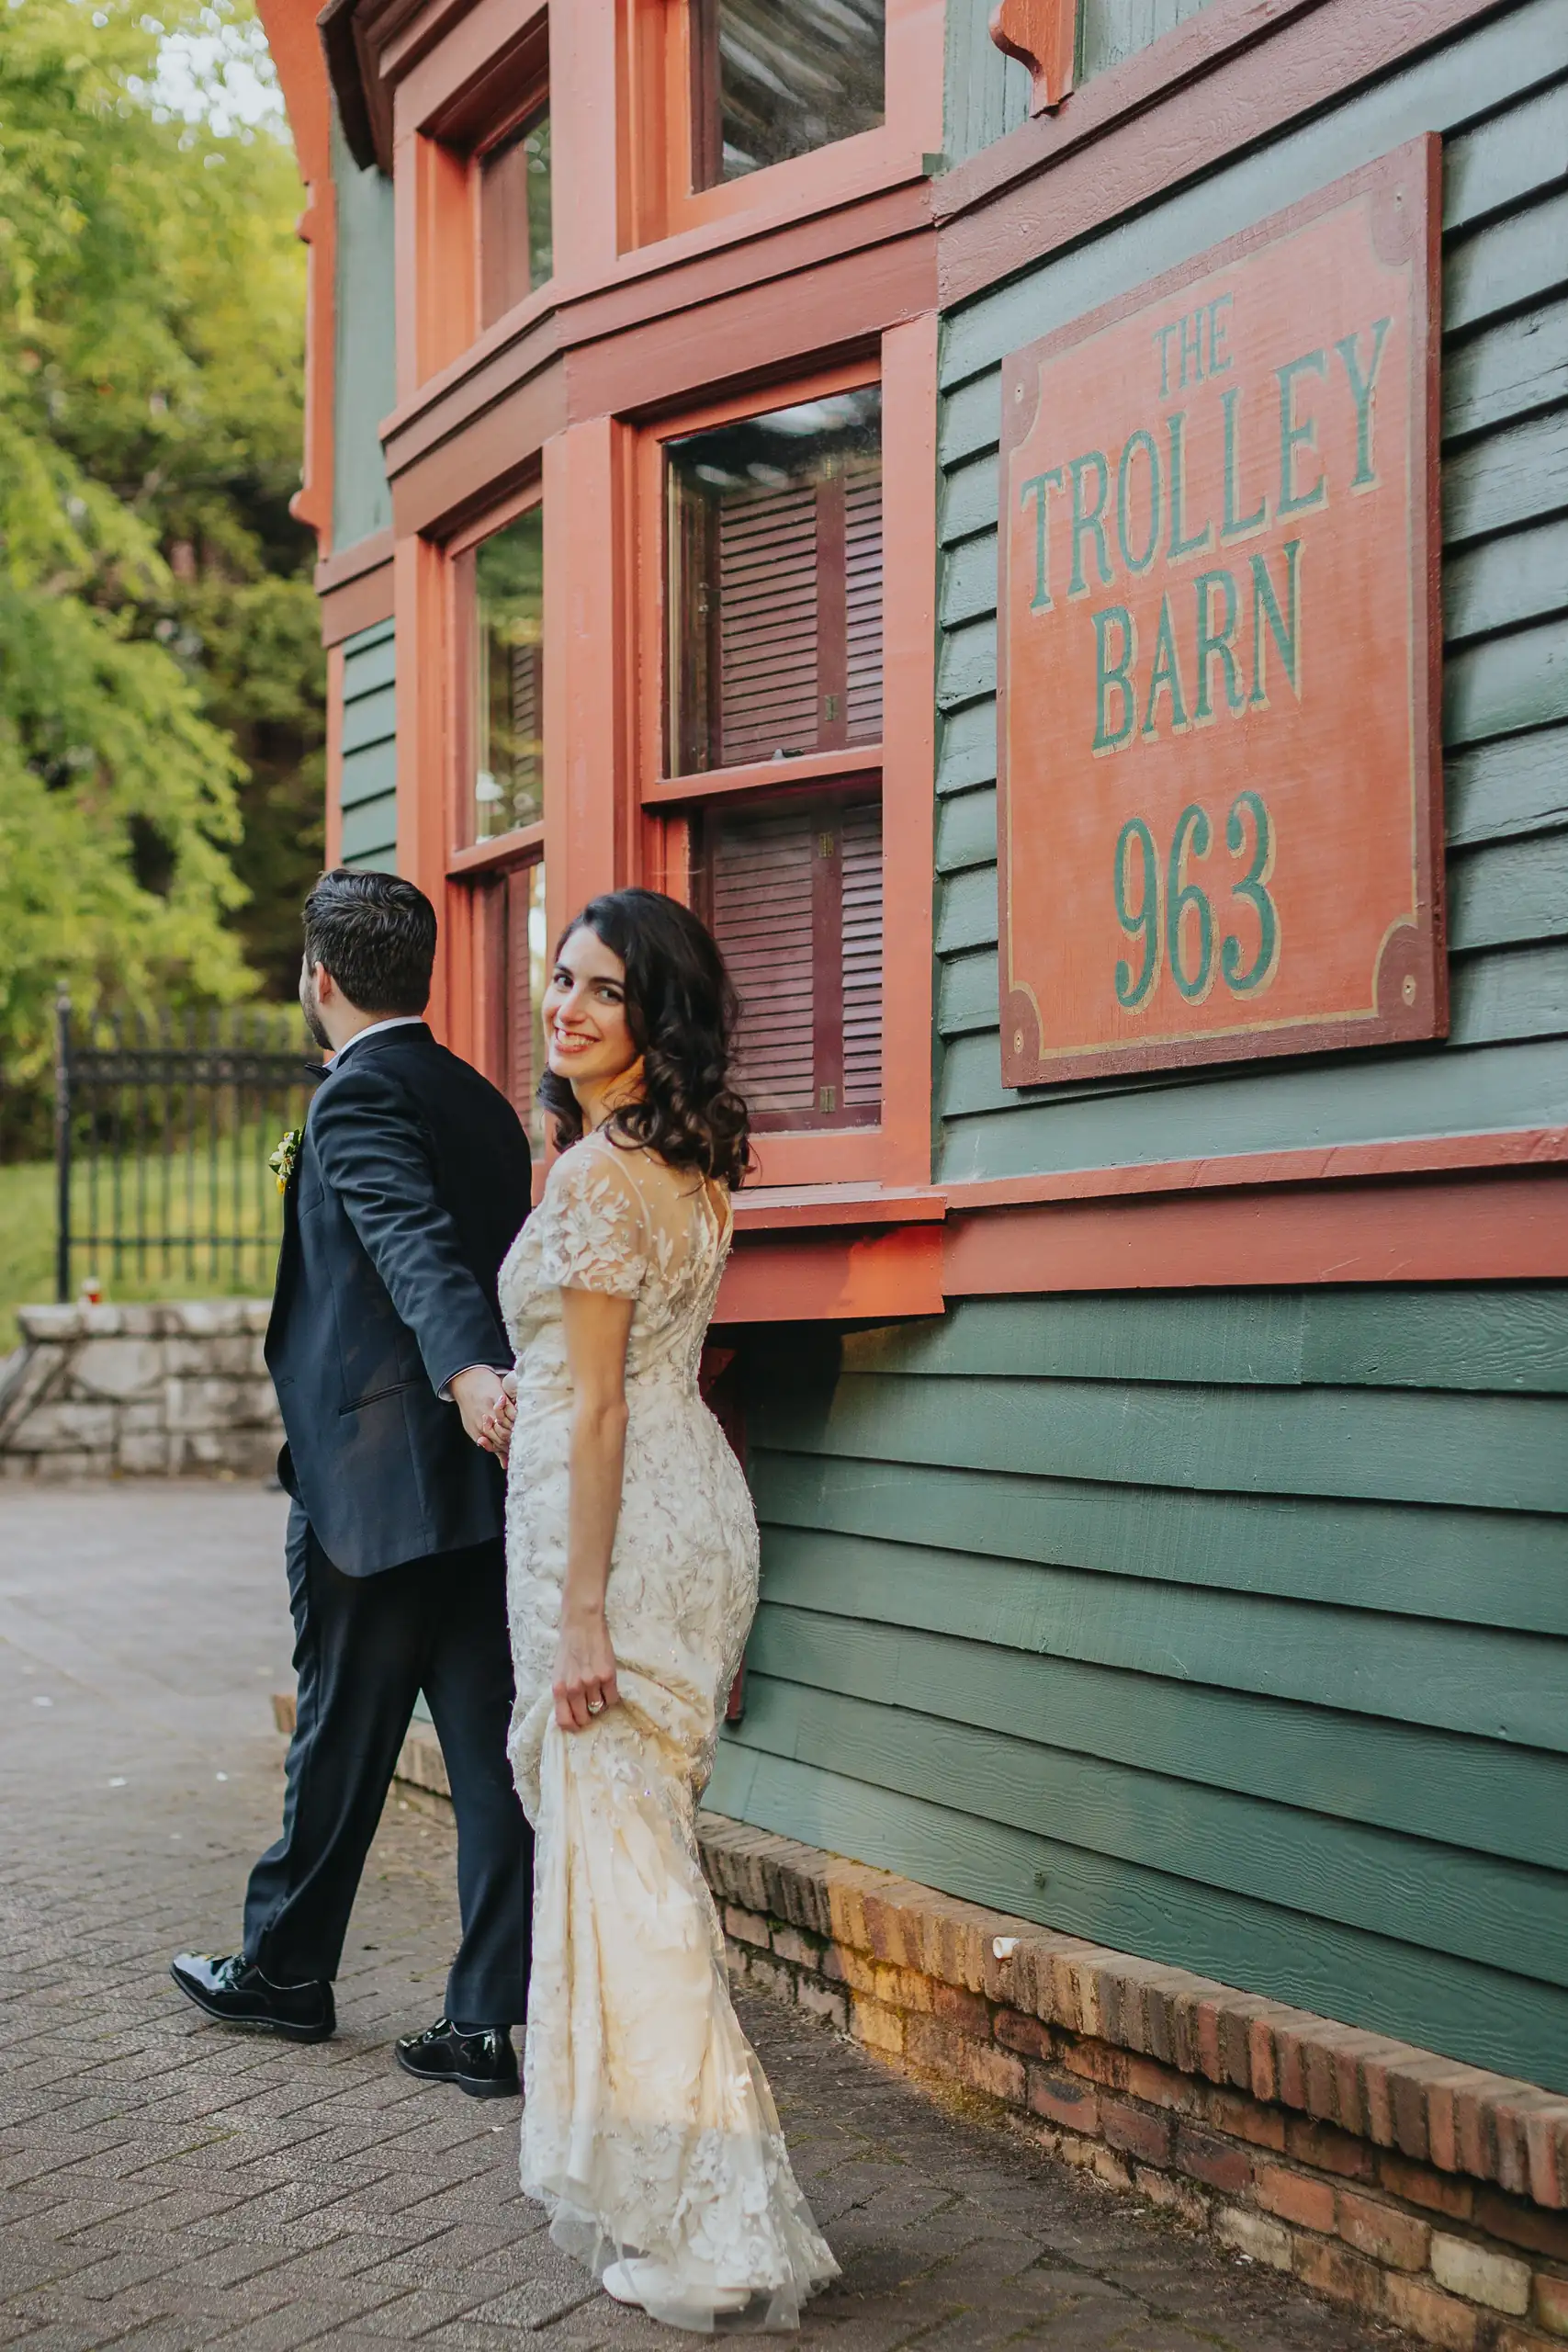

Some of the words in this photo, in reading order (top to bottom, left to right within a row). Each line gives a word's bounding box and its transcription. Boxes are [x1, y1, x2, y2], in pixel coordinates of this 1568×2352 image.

[1153, 293, 1233, 400] THE
[1021, 317, 1393, 613] TROLLEY
[1091, 539, 1304, 757] BARN
[1114, 790, 1280, 1014] 963
